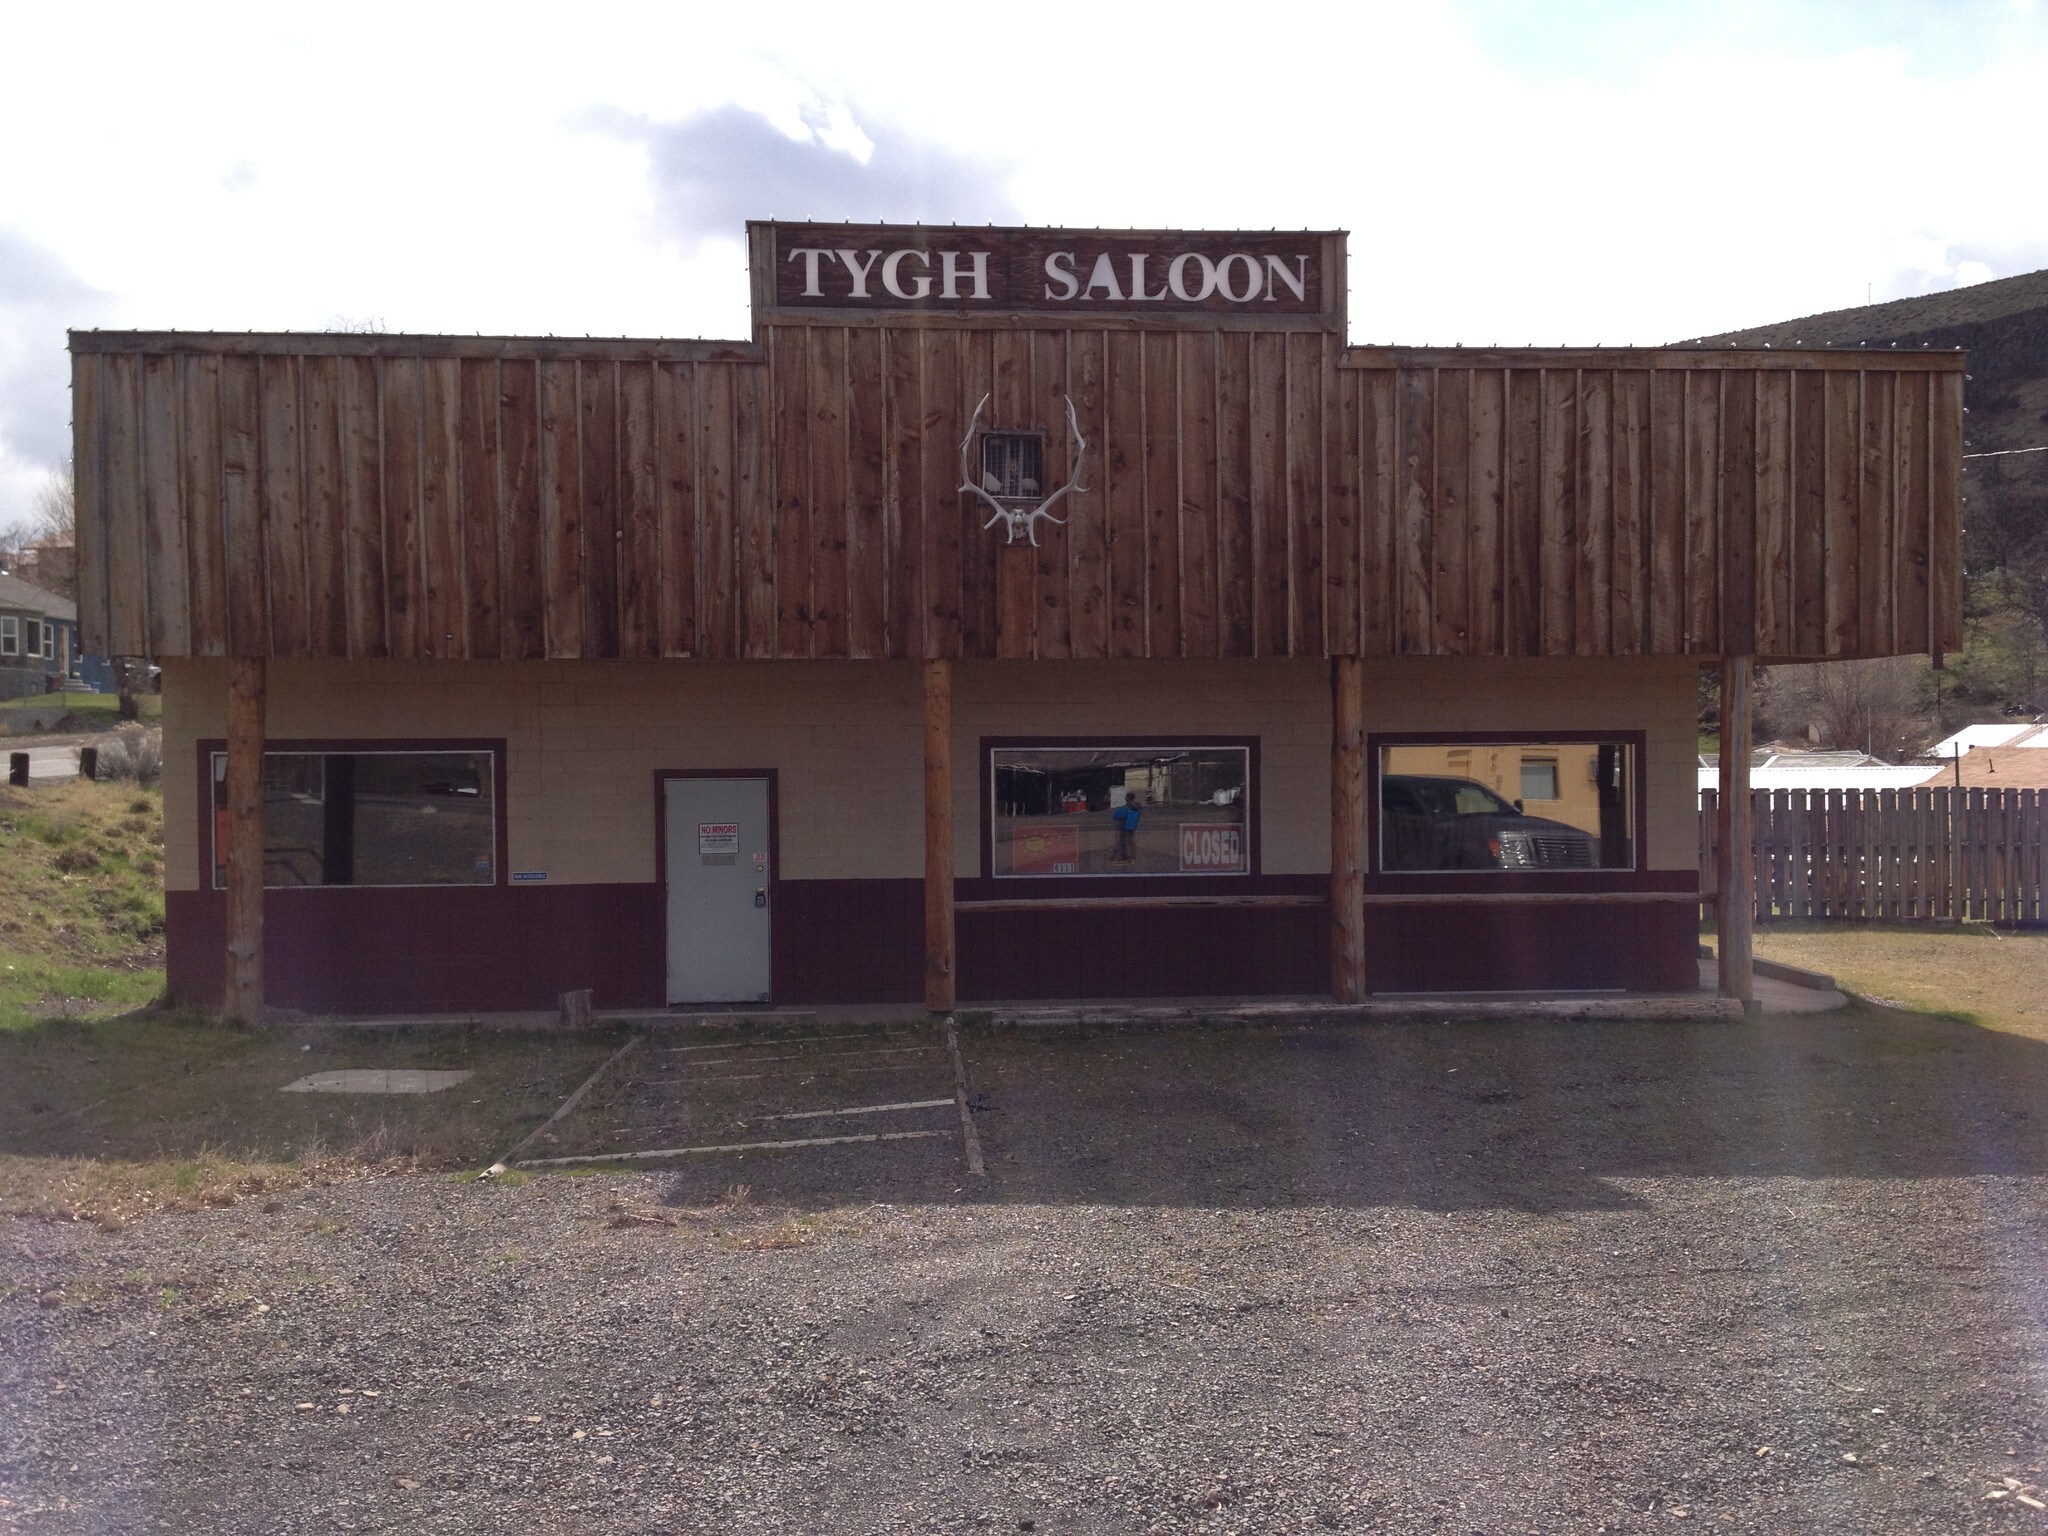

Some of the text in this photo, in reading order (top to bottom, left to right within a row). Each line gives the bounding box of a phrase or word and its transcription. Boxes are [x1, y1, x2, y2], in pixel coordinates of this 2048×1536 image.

[787, 248, 1310, 302] TYGH SALOON
[701, 825, 737, 834] NO MINORS
[1184, 830, 1240, 865] CLOSED
